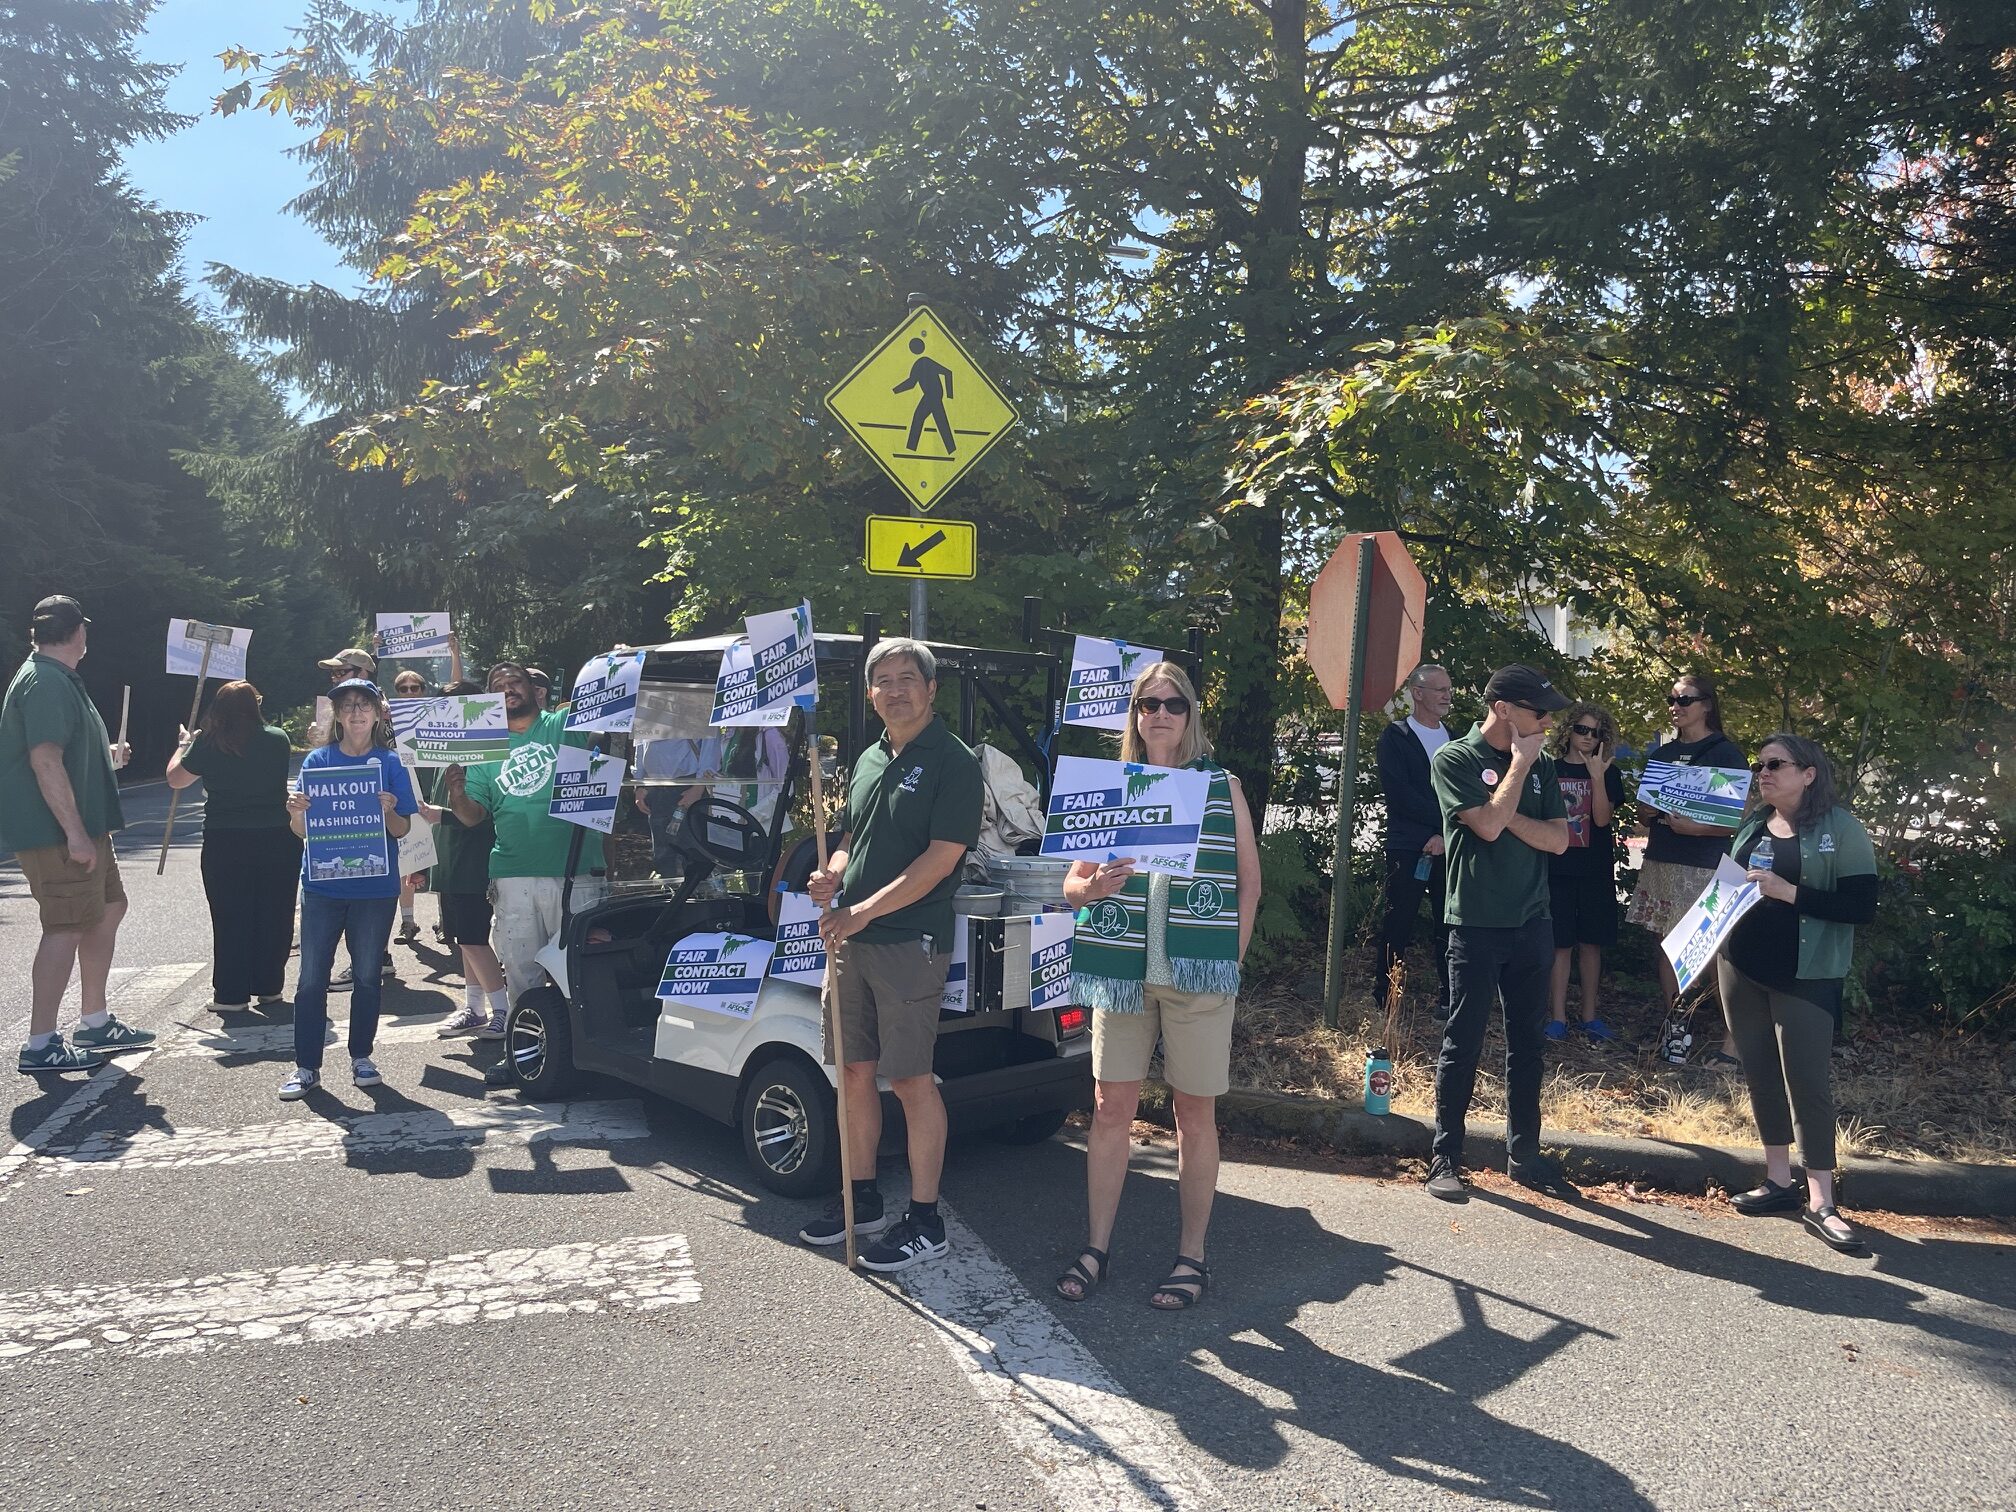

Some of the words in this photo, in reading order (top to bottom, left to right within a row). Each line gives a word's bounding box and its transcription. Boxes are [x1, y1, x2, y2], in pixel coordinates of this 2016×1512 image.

[383, 627, 403, 637] FAIR
[385, 629, 435, 645] CONTRACT
[387, 643, 414, 654] NOW!
[761, 642, 787, 667] FAIR
[765, 644, 814, 683] CONTRAC
[723, 670, 748, 688] FAIR
[1079, 669, 1109, 684] FAIR
[578, 681, 598, 697] FAIR
[722, 684, 757, 703] CONTR
[767, 675, 798, 702] NOW!
[1078, 683, 1132, 701] CONTRA
[576, 685, 626, 711] CONTRACT
[574, 707, 602, 725] NOW!
[721, 699, 753, 719] NOW!
[1078, 701, 1117, 718] NOW!
[420, 730, 466, 738] WALKOUT
[417, 741, 448, 750] WITH
[421, 752, 484, 761] WASHINGTON
[560, 772, 581, 784] FAIR
[1559, 781, 1588, 791] ONKEY
[308, 781, 377, 797] WALKOUT
[560, 784, 607, 798] CONTRACT
[1664, 787, 1707, 801] WALKOUT
[1675, 782, 1703, 792] 8.31.26
[332, 800, 355, 811] FOR
[559, 800, 585, 812] NOW!
[1062, 792, 1106, 811] FAIR
[1658, 793, 1687, 807] WITH
[309, 814, 381, 828] WASHINGTON
[1063, 807, 1170, 830] CONTRACT
[1061, 830, 1118, 850] NOW!
[1151, 857, 1188, 870] AFSCME
[784, 923, 810, 939] FAIR
[1685, 890, 1739, 969] CONTRACT
[784, 938, 826, 955] CONTR
[1039, 942, 1067, 965] FAIR
[1680, 928, 1704, 964] FAIR
[676, 950, 707, 963] FAIR
[1689, 933, 1718, 977] NOW!
[674, 964, 745, 979] CONTRACT
[782, 955, 816, 972] NOW!
[1041, 958, 1071, 982] CONT
[671, 982, 710, 995] NOW!
[1044, 977, 1070, 1001] NOW
[942, 993, 962, 1004] FSCME
